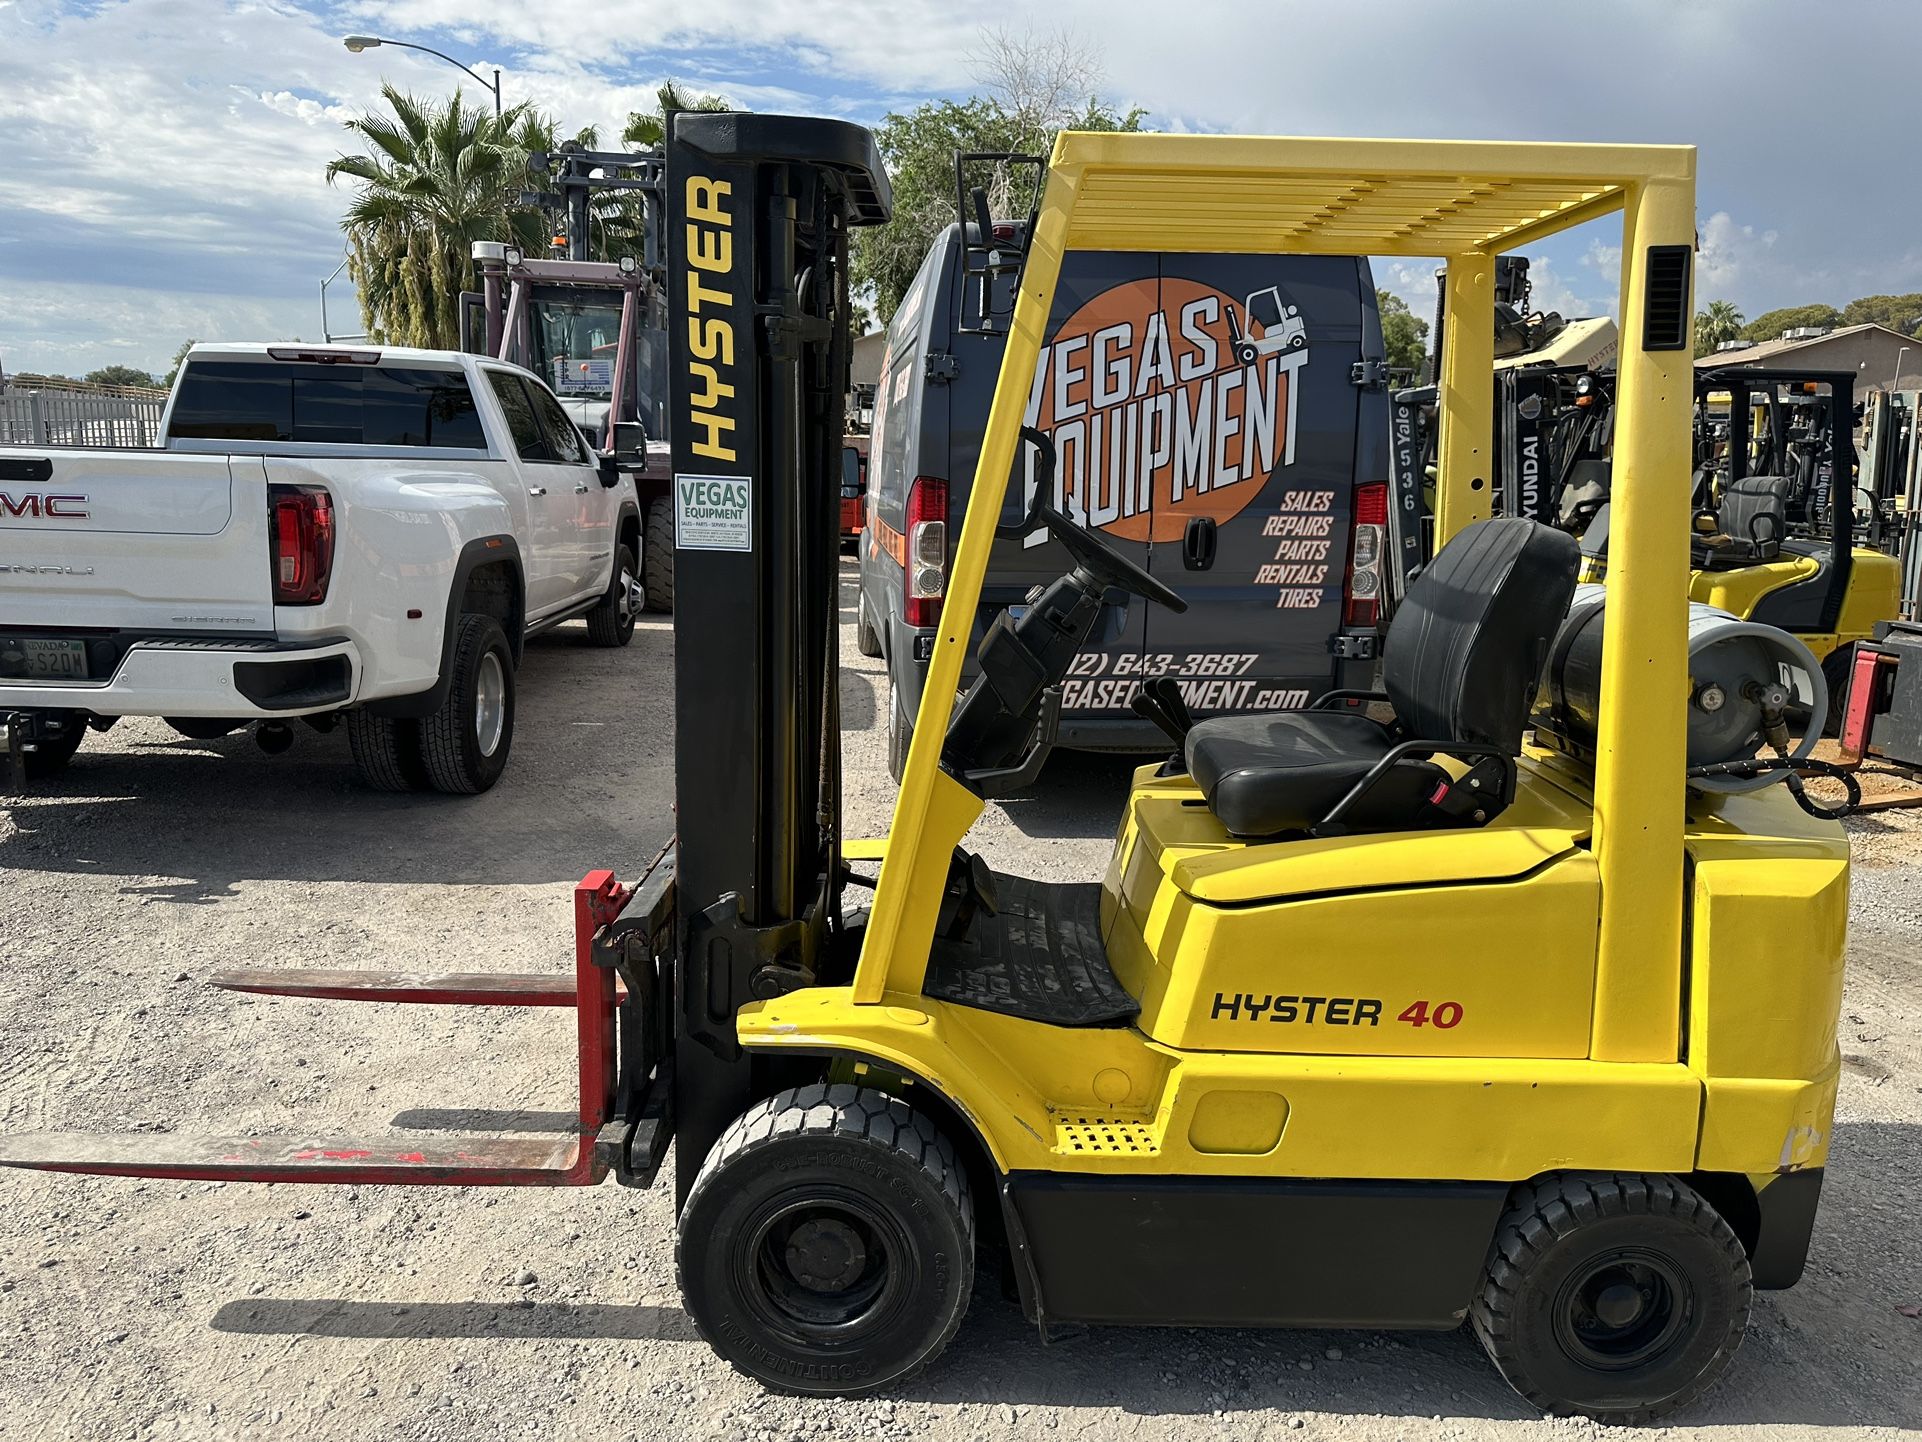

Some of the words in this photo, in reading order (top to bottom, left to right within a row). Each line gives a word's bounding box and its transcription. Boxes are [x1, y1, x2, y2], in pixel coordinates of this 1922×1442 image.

[685, 174, 737, 462] HYSTER
[1022, 294, 1219, 431] VEGAS
[1396, 406, 1411, 446] Yale
[1523, 435, 1538, 523] YUNDAI
[0, 491, 90, 519] MC
[680, 482, 747, 509] VEGAS
[1280, 491, 1335, 512] SALES
[685, 507, 744, 520] EQUIPMENT
[1261, 515, 1334, 536] REPAIRS
[1274, 540, 1331, 560] PARTS
[0, 564, 95, 576] NALI
[1253, 564, 1329, 584] RENTALS
[1276, 588, 1323, 608] TIRES
[1112, 653, 1259, 676] 643-3687
[1210, 992, 1383, 1027] HYSTER
[1397, 1000, 1464, 1029] 40
